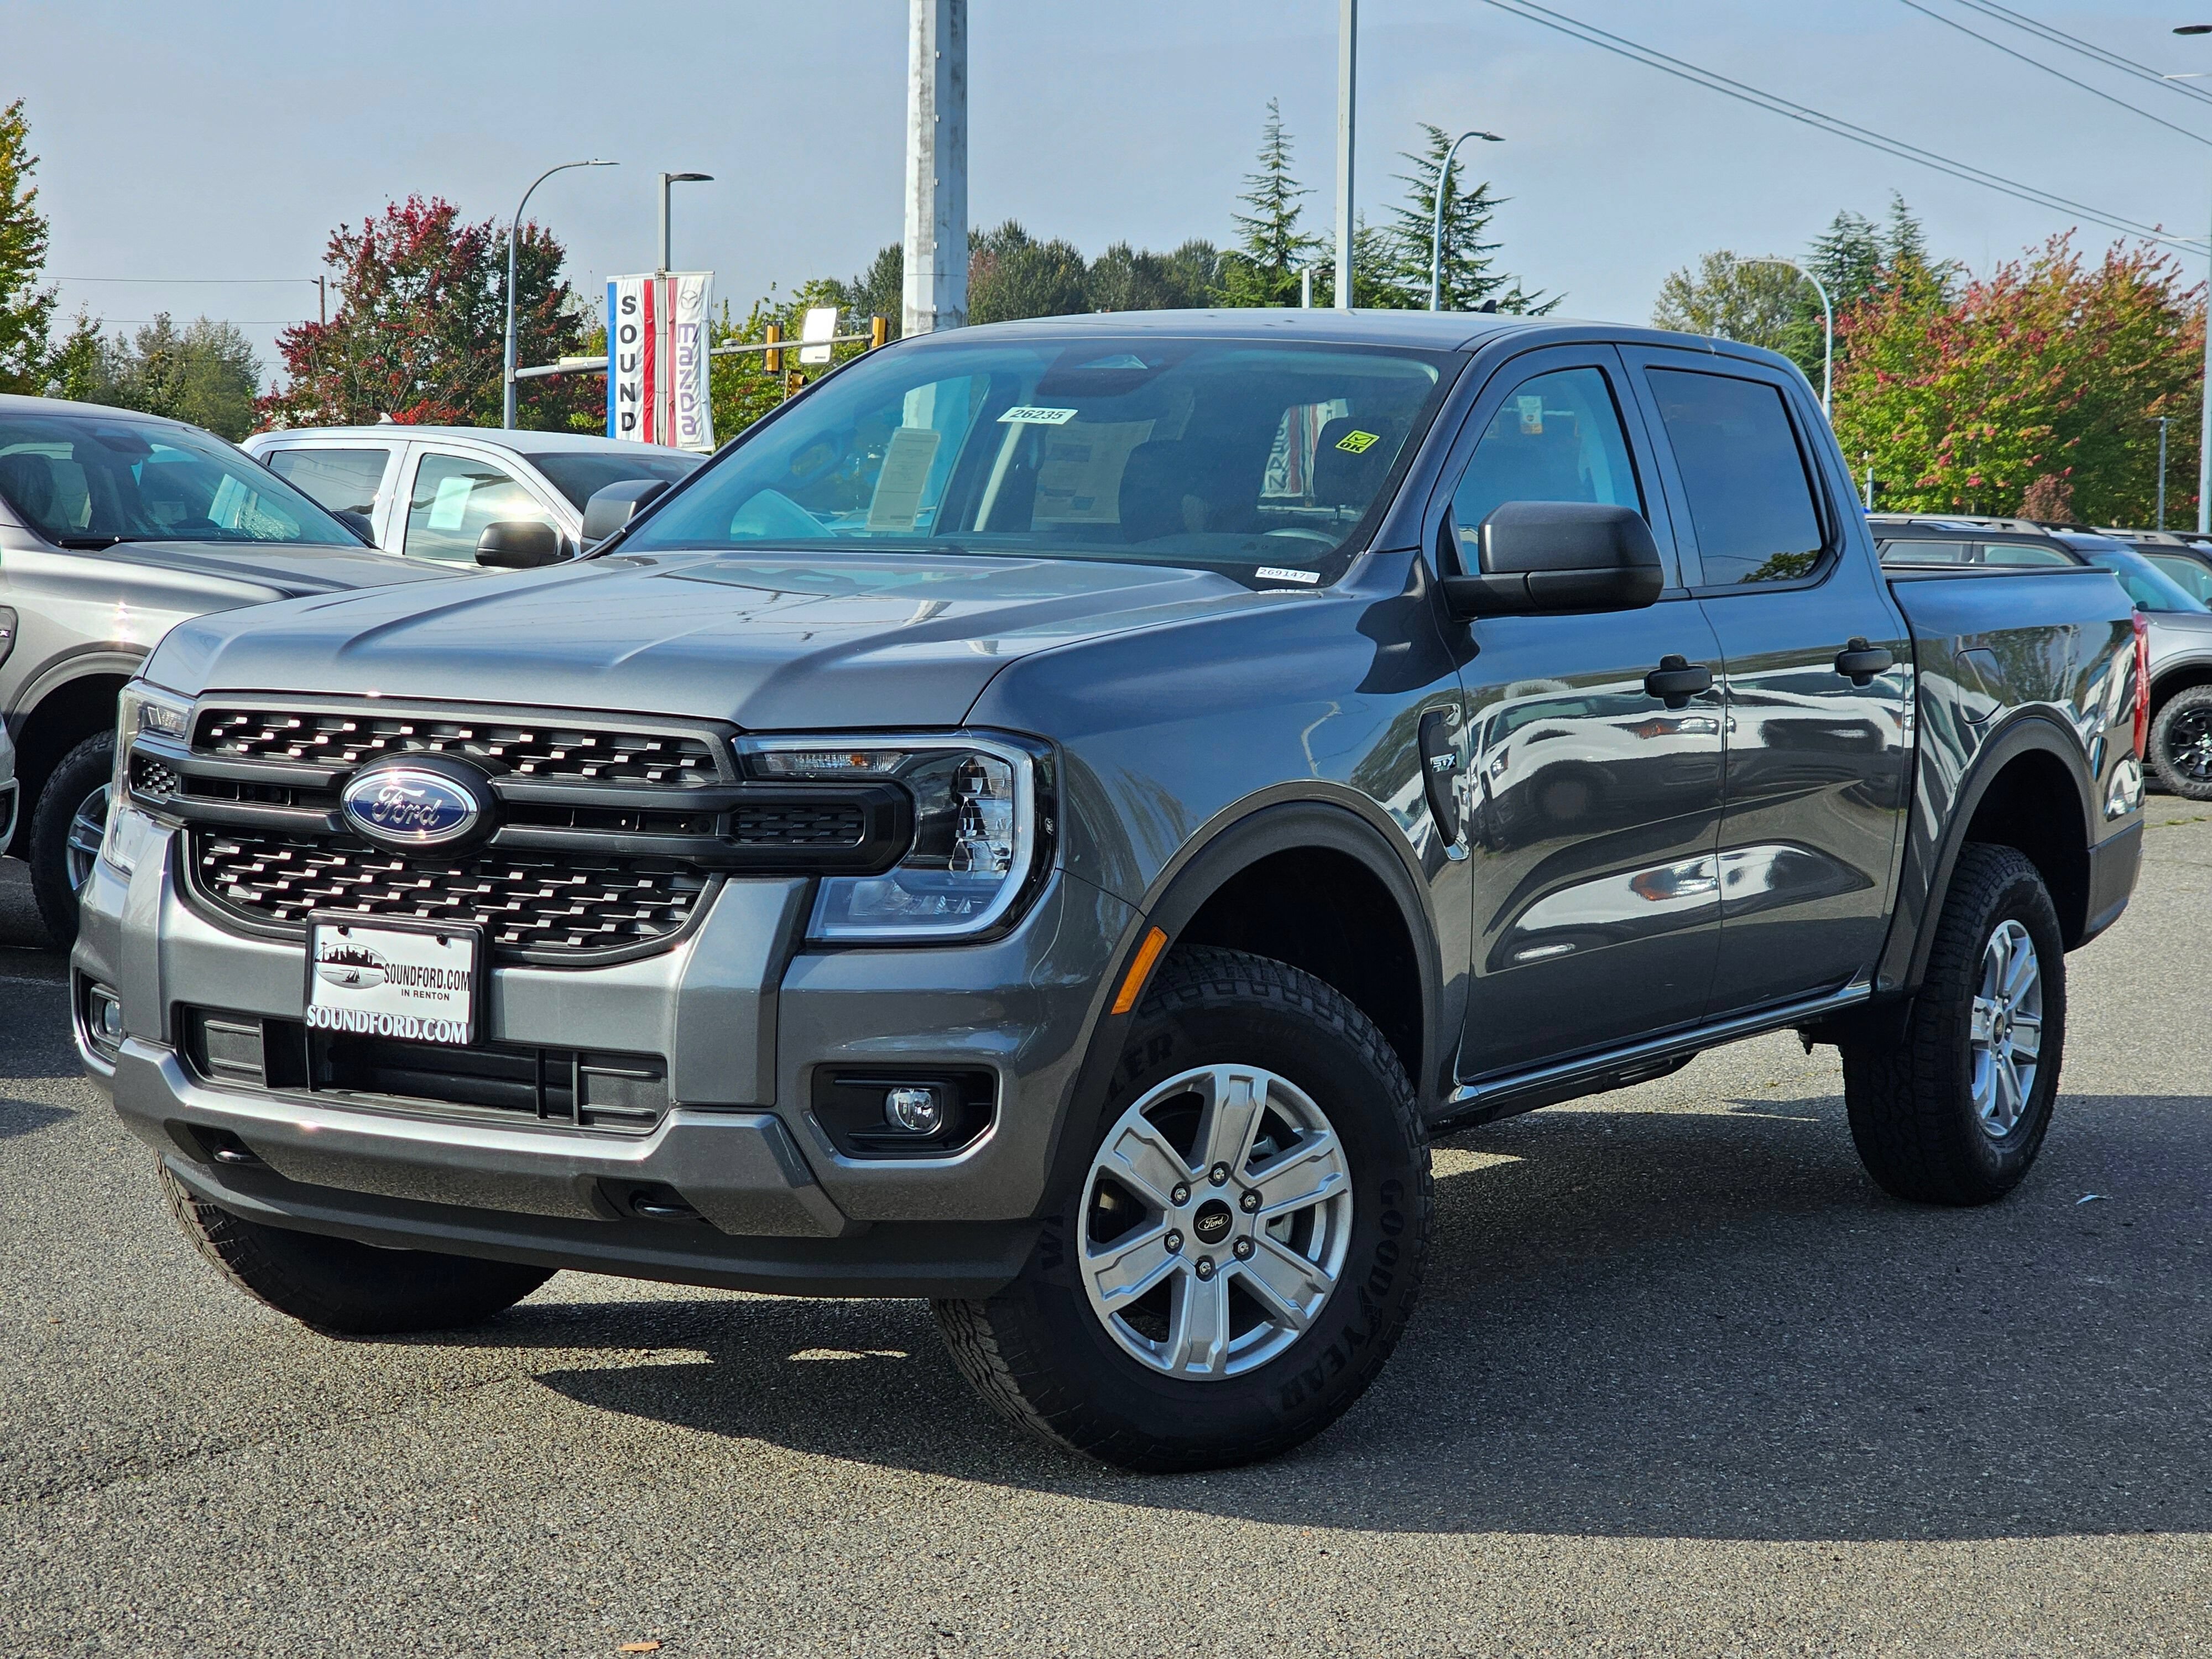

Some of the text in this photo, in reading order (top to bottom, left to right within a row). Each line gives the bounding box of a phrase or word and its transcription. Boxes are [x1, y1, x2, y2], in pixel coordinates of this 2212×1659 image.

[620, 295, 637, 431] SOUND
[1010, 409, 1066, 420] 26235
[1339, 441, 1365, 452] OK
[1259, 568, 1306, 578] 269147
[371, 784, 443, 826] Ford
[384, 962, 471, 992] SOUNDFORD.COM
[401, 988, 450, 1001] IN RENTON
[306, 1004, 468, 1045] SOUNDFORD.COM
[1204, 1215, 1224, 1229] Ford
